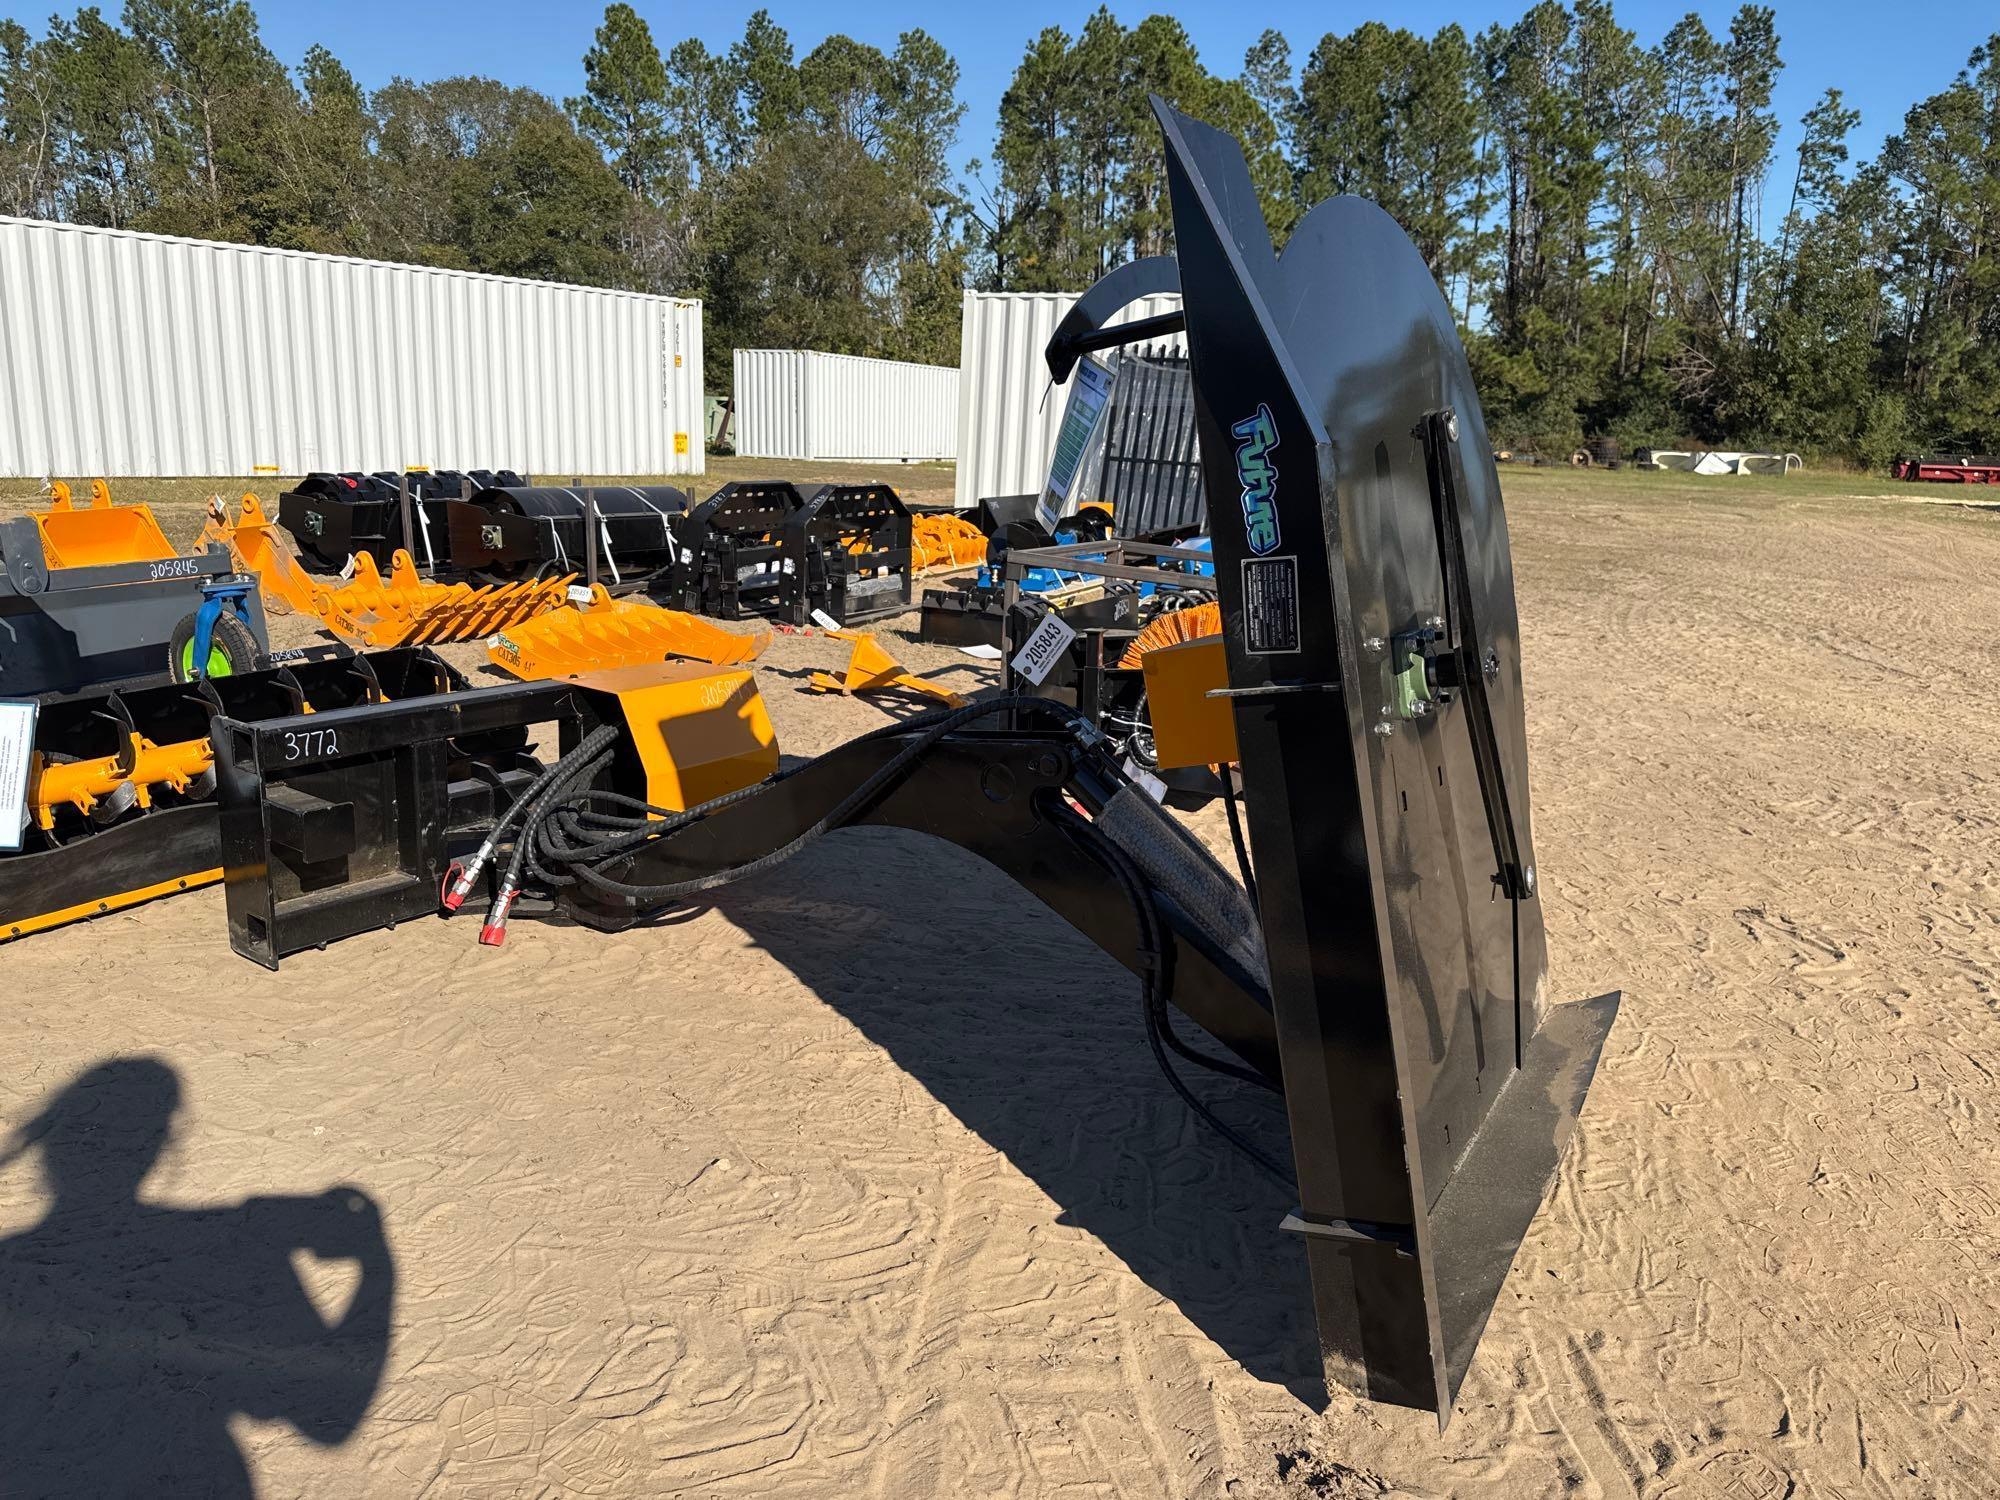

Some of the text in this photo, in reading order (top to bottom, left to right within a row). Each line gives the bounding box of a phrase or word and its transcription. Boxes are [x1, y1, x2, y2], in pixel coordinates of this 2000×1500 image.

[1231, 402, 1281, 556] Future
[149, 559, 199, 579] 205845
[497, 646, 521, 667] CAT305
[1025, 622, 1062, 666] 205843
[284, 728, 340, 761] 3772
